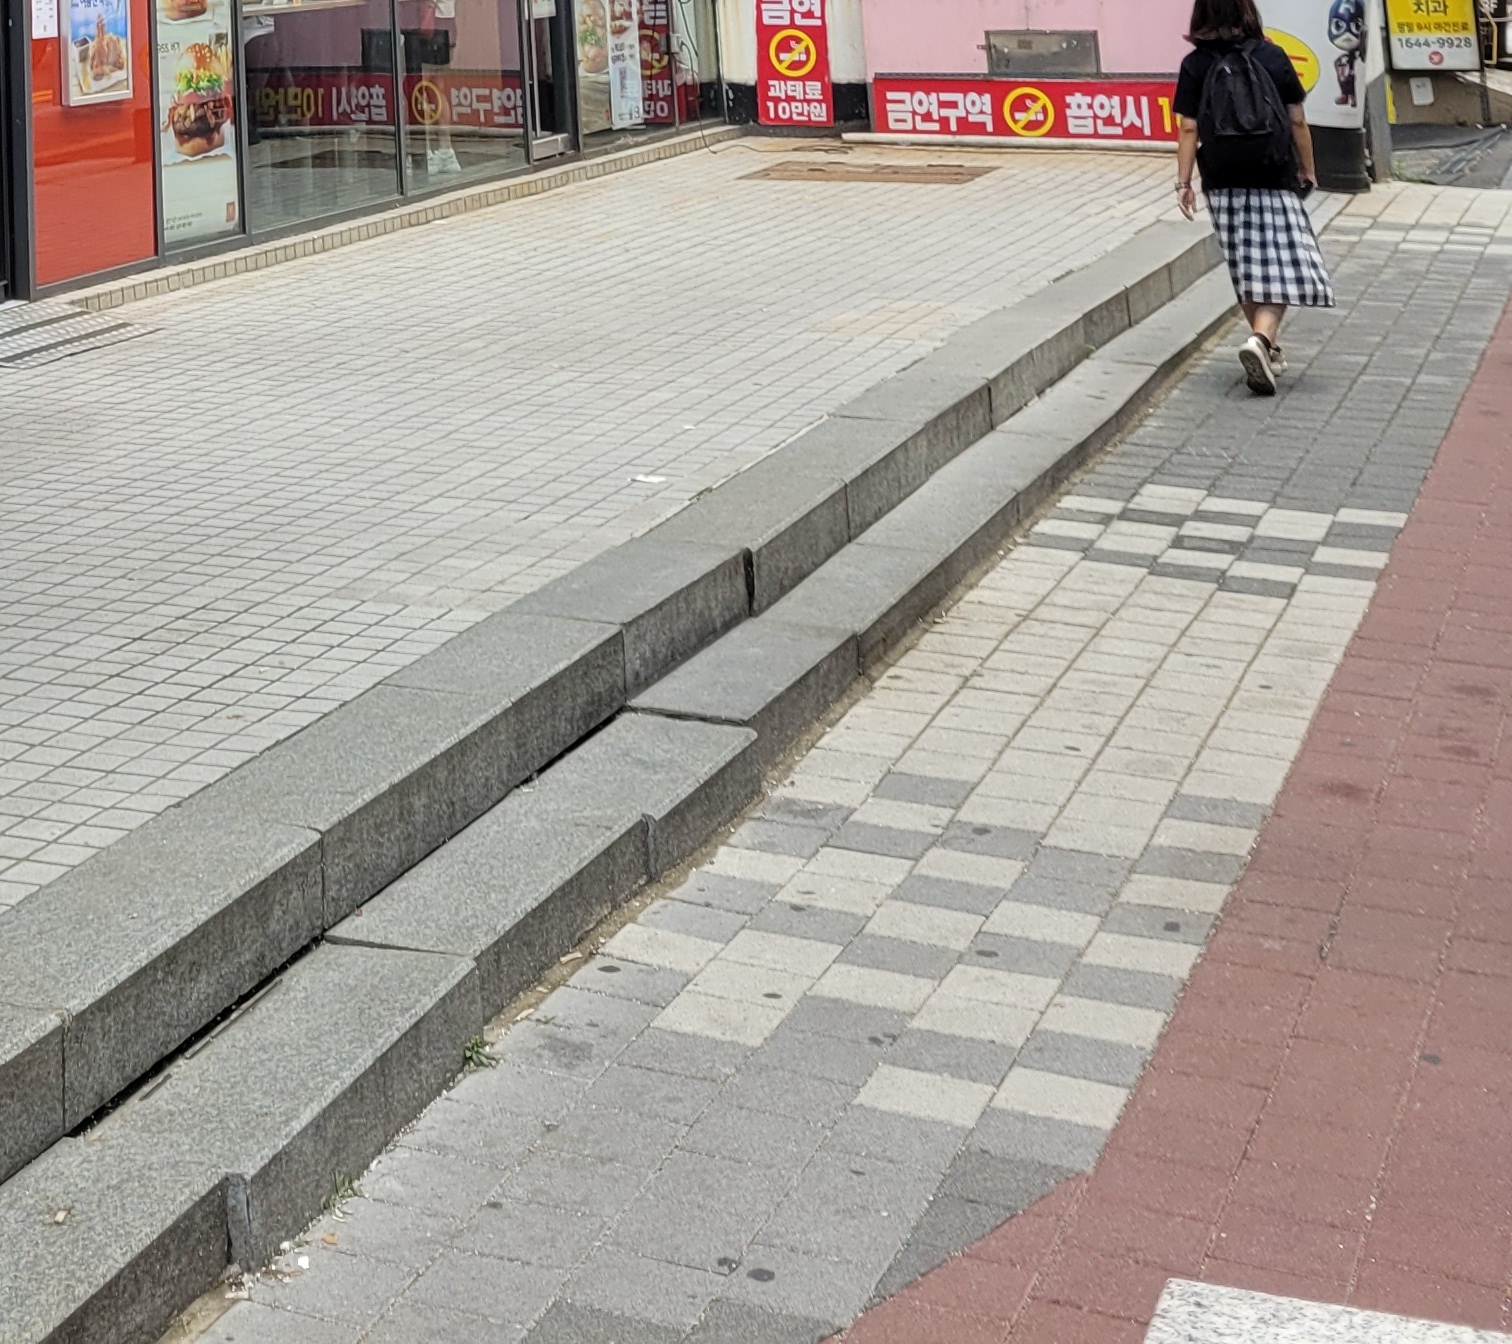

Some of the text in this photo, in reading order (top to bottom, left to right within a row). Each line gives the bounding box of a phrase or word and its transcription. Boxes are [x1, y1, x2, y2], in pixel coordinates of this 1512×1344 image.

[1397, 36, 1472, 49] 1644-9928
[768, 80, 823, 100] 과태료
[767, 101, 827, 122] 10만원
[885, 91, 1151, 136] 금연구역 흡연시
